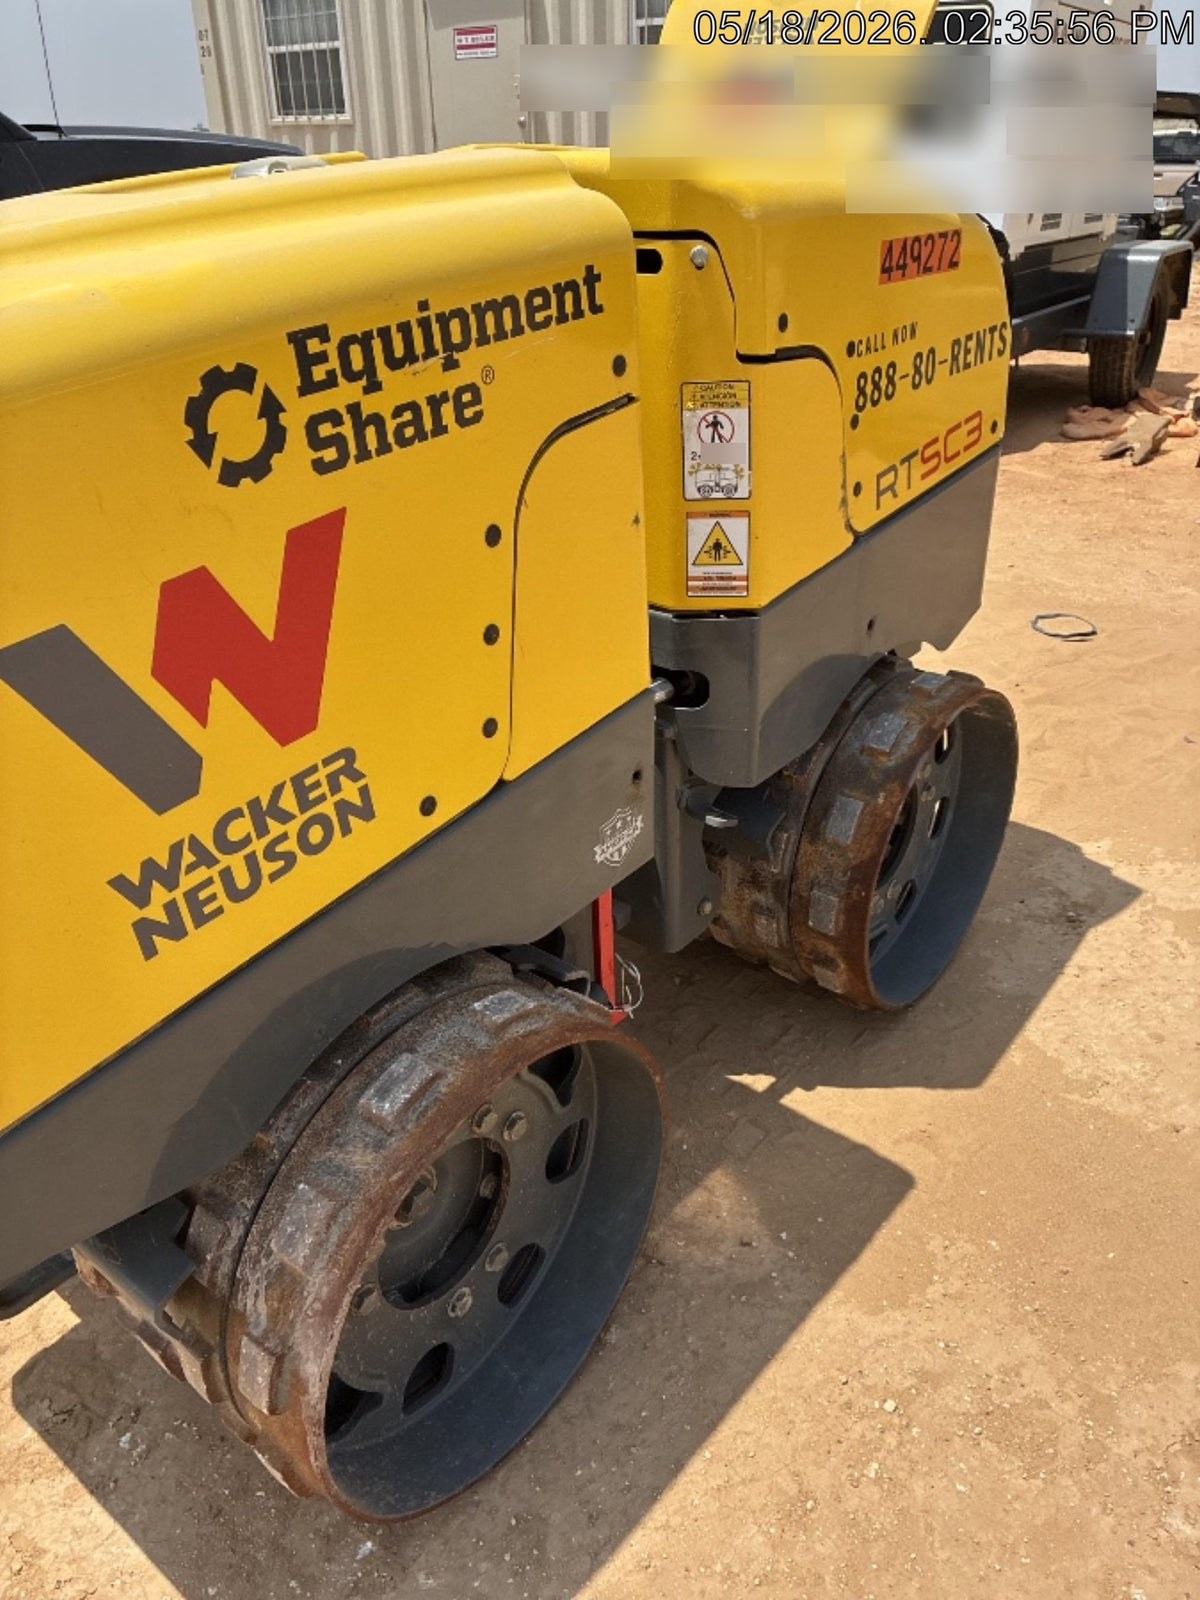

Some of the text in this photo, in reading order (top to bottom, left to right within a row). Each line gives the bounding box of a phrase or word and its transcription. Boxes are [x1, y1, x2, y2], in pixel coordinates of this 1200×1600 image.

[881, 229, 962, 281] 449272
[286, 264, 604, 395] Equipment
[855, 321, 1008, 413] 888-80-RENTS
[856, 321, 918, 358] CALL NOW
[876, 410, 982, 511] RTSC3
[106, 747, 367, 911] WACKER
[131, 783, 376, 963] NEUSON
